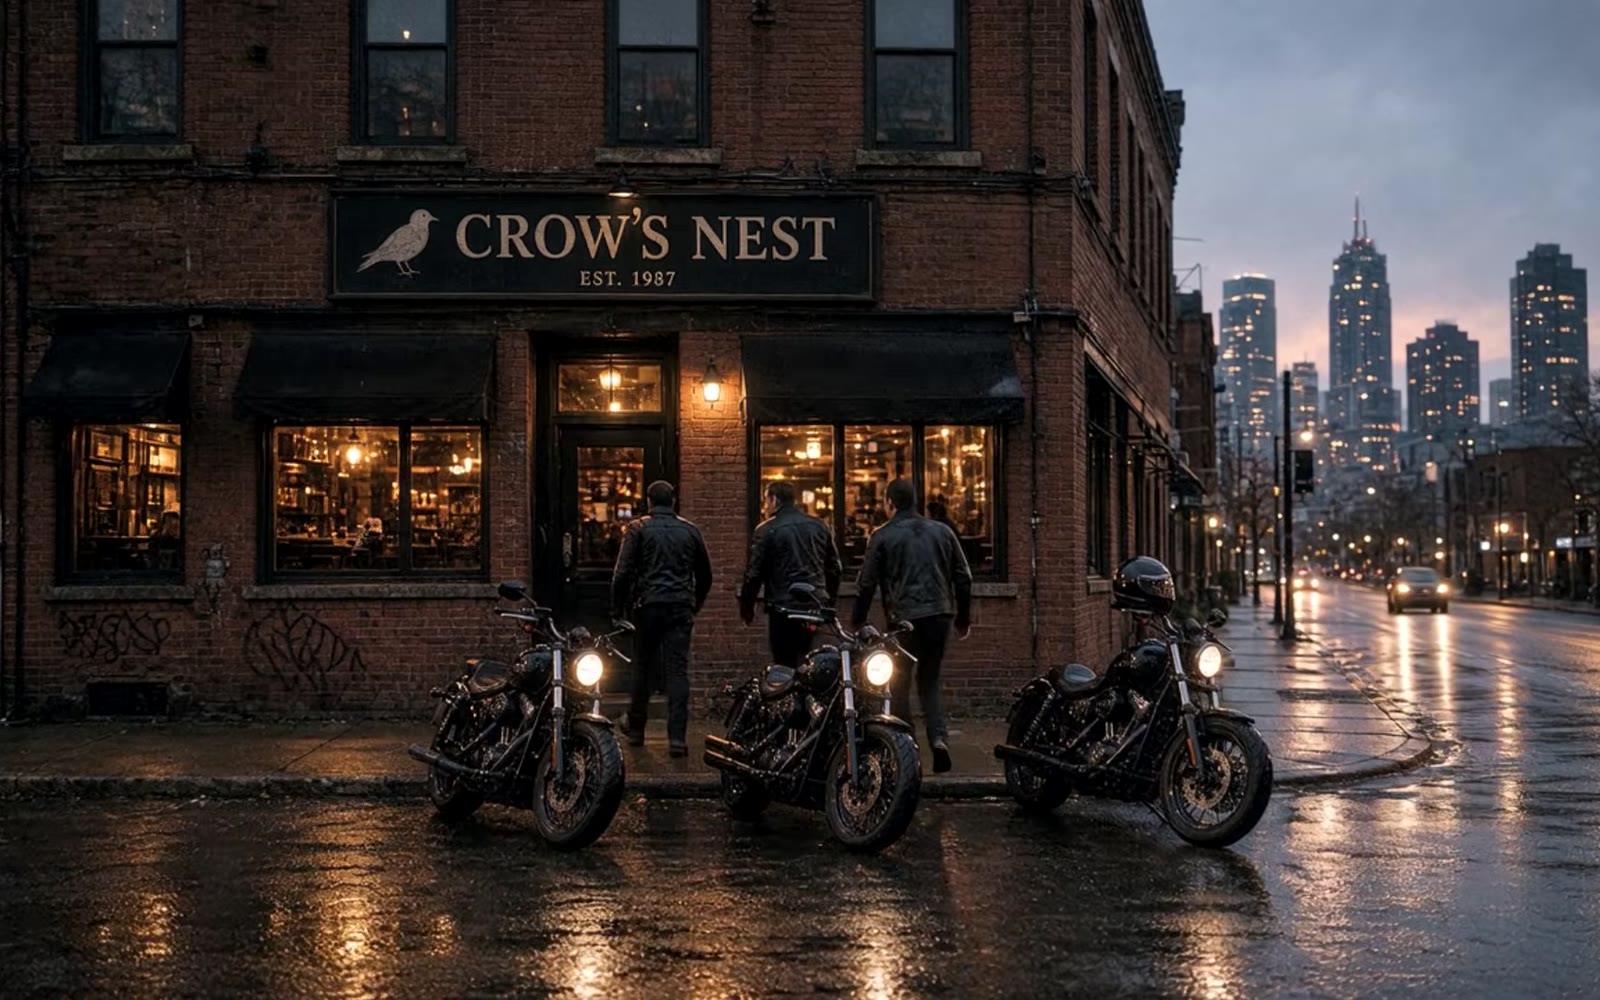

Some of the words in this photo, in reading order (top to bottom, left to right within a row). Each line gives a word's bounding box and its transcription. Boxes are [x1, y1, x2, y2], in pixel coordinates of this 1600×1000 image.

[455, 206, 669, 260] CROW’S
[692, 215, 836, 261] NEST
[579, 270, 622, 287] EST.
[632, 270, 676, 288] 1987
